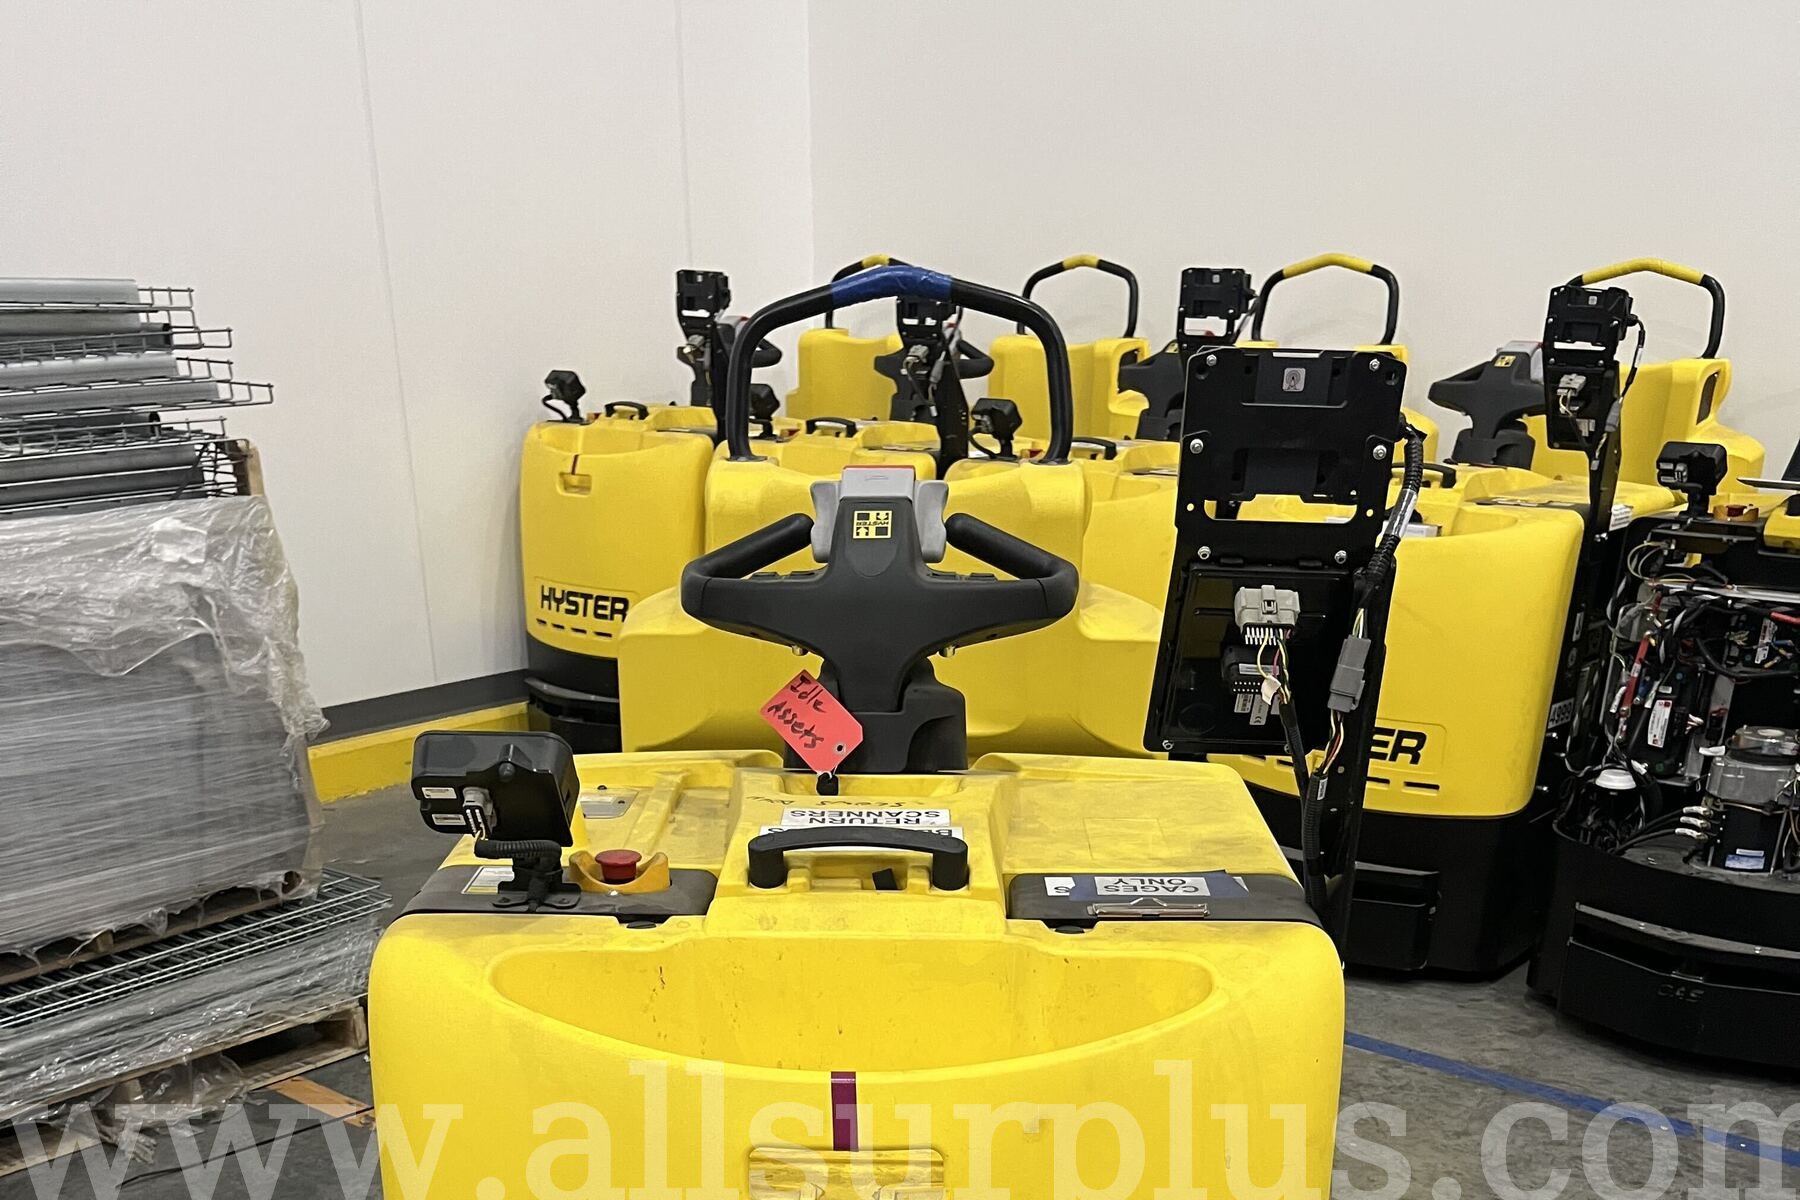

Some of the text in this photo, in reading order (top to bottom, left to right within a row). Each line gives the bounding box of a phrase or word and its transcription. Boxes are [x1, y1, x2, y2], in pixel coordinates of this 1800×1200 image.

[541, 585, 629, 623] HYSTER
[790, 809, 941, 818] SCANNERS
[808, 817, 920, 825] RETURN
[1113, 878, 1187, 886] ONLY
[1103, 884, 1200, 893] CAGES
